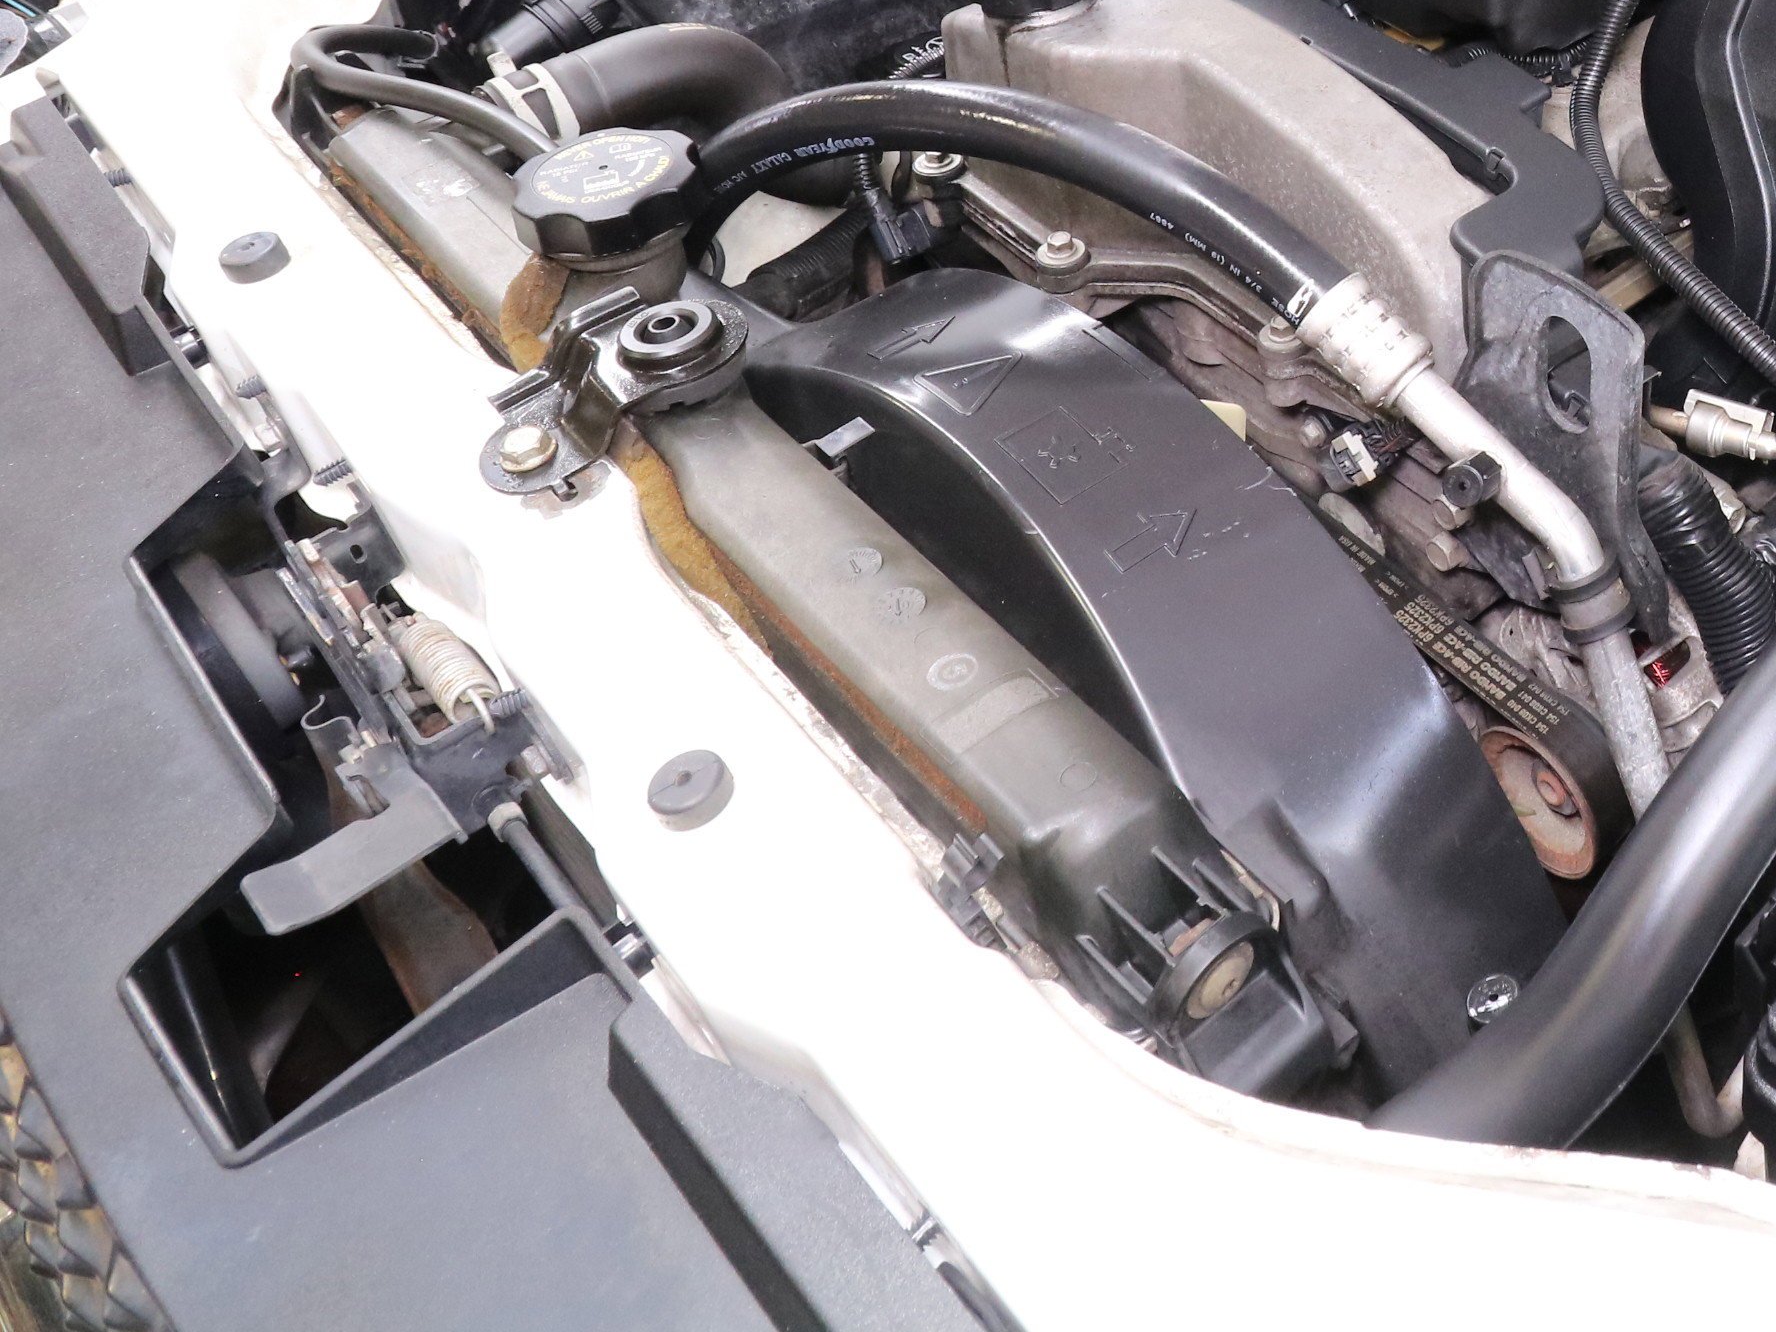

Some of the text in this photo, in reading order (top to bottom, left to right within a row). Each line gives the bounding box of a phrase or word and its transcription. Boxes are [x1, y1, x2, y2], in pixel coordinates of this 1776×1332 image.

[793, 135, 875, 157] GOODYEAR
[581, 186, 635, 204] OUVRIR
[1184, 232, 1300, 325] HOSE 3/4 IN (19 MM)
[1393, 608, 1434, 642] 6PK2325
[1403, 601, 1444, 634] 6PK2325
[1414, 593, 1454, 626] 6PK2325
[1431, 640, 1471, 673] RIB-ACE
[1442, 632, 1482, 665] RIB-ACE
[1479, 660, 1516, 691] BANDO
[1490, 652, 1526, 682] BANDO
[1468, 669, 1506, 700] BANDO
